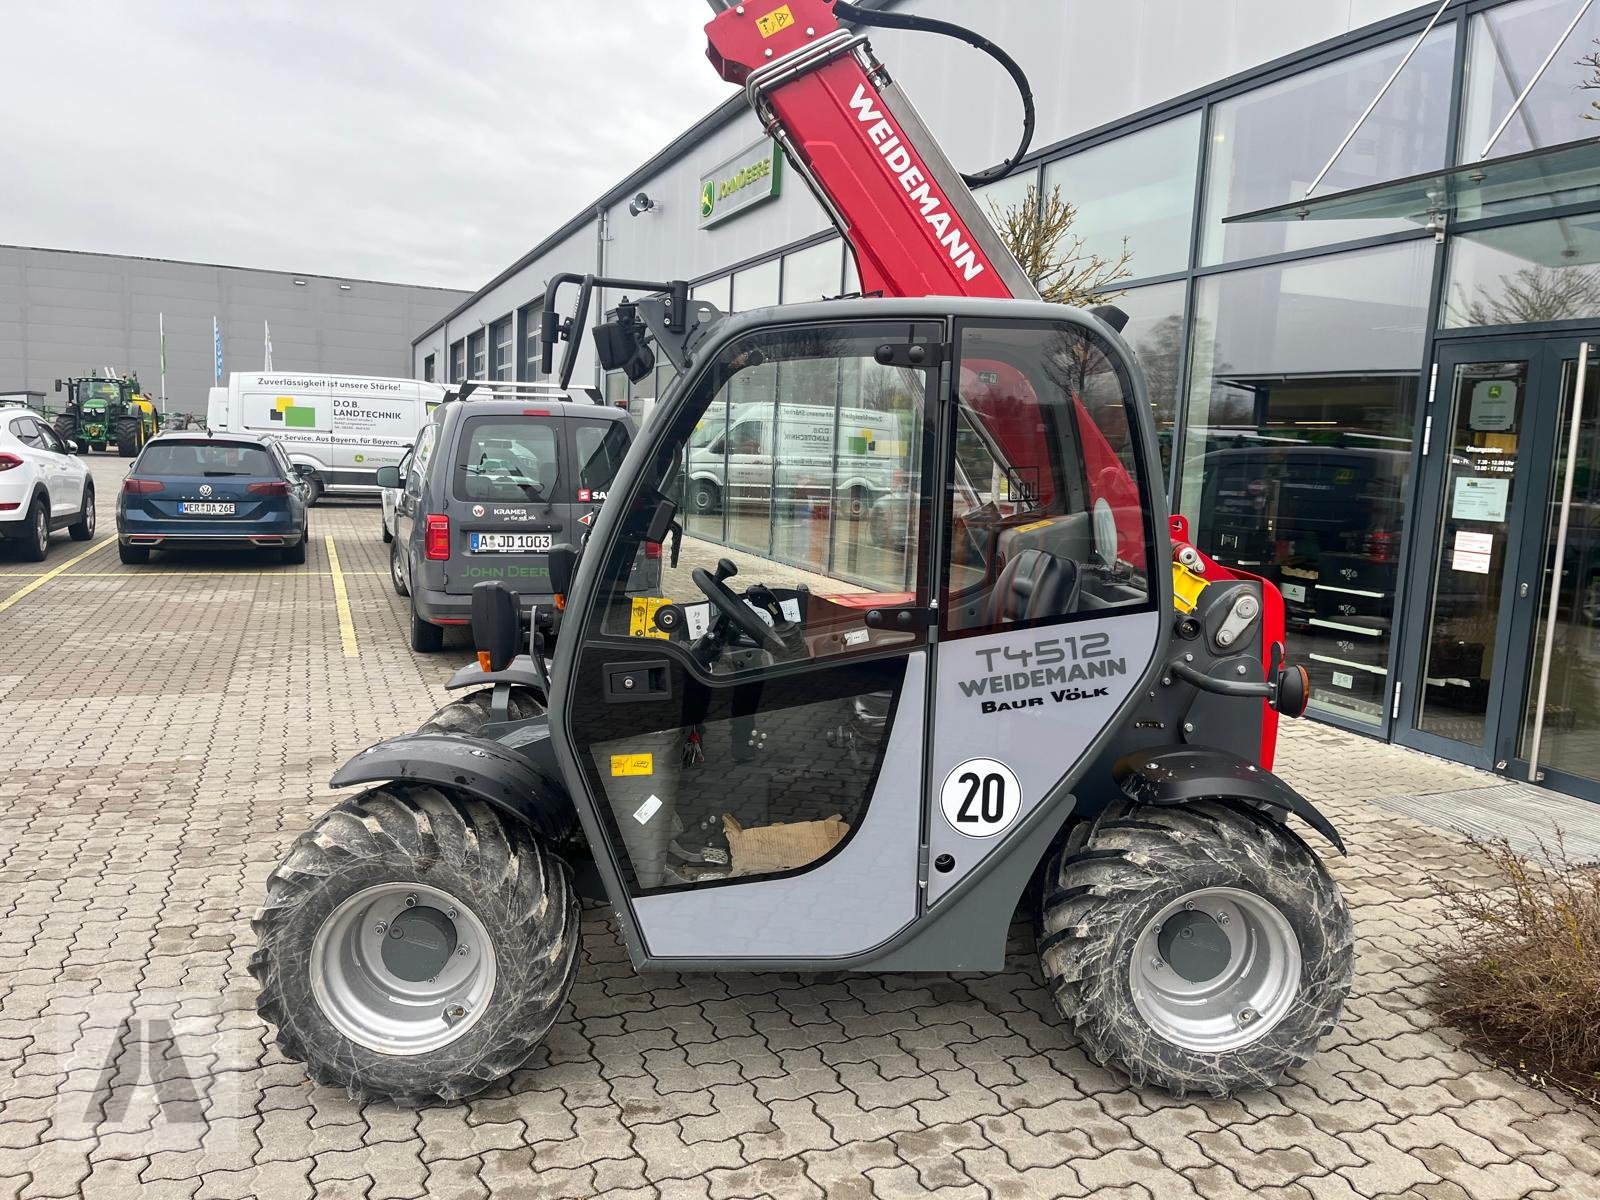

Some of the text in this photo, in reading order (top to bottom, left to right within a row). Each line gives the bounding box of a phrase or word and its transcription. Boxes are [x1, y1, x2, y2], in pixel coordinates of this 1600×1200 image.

[848, 84, 985, 282] WEIDEMANN
[258, 377, 326, 390] Zuverlässigkeit
[328, 380, 338, 388] ist
[370, 382, 400, 391] Stärke!
[334, 400, 360, 408] D.O.B.
[334, 409, 401, 419] LANDTECHNIK
[372, 438, 400, 446] Bayern.
[480, 537, 488, 547] A
[498, 536, 514, 547] JD
[518, 536, 550, 547] 1003
[461, 565, 549, 577] JOHN DEER
[976, 632, 1111, 672] T4512
[959, 657, 1126, 698] WEIDEMANN
[981, 686, 1109, 714] BAUR VÖLK
[957, 772, 1005, 824] 20
